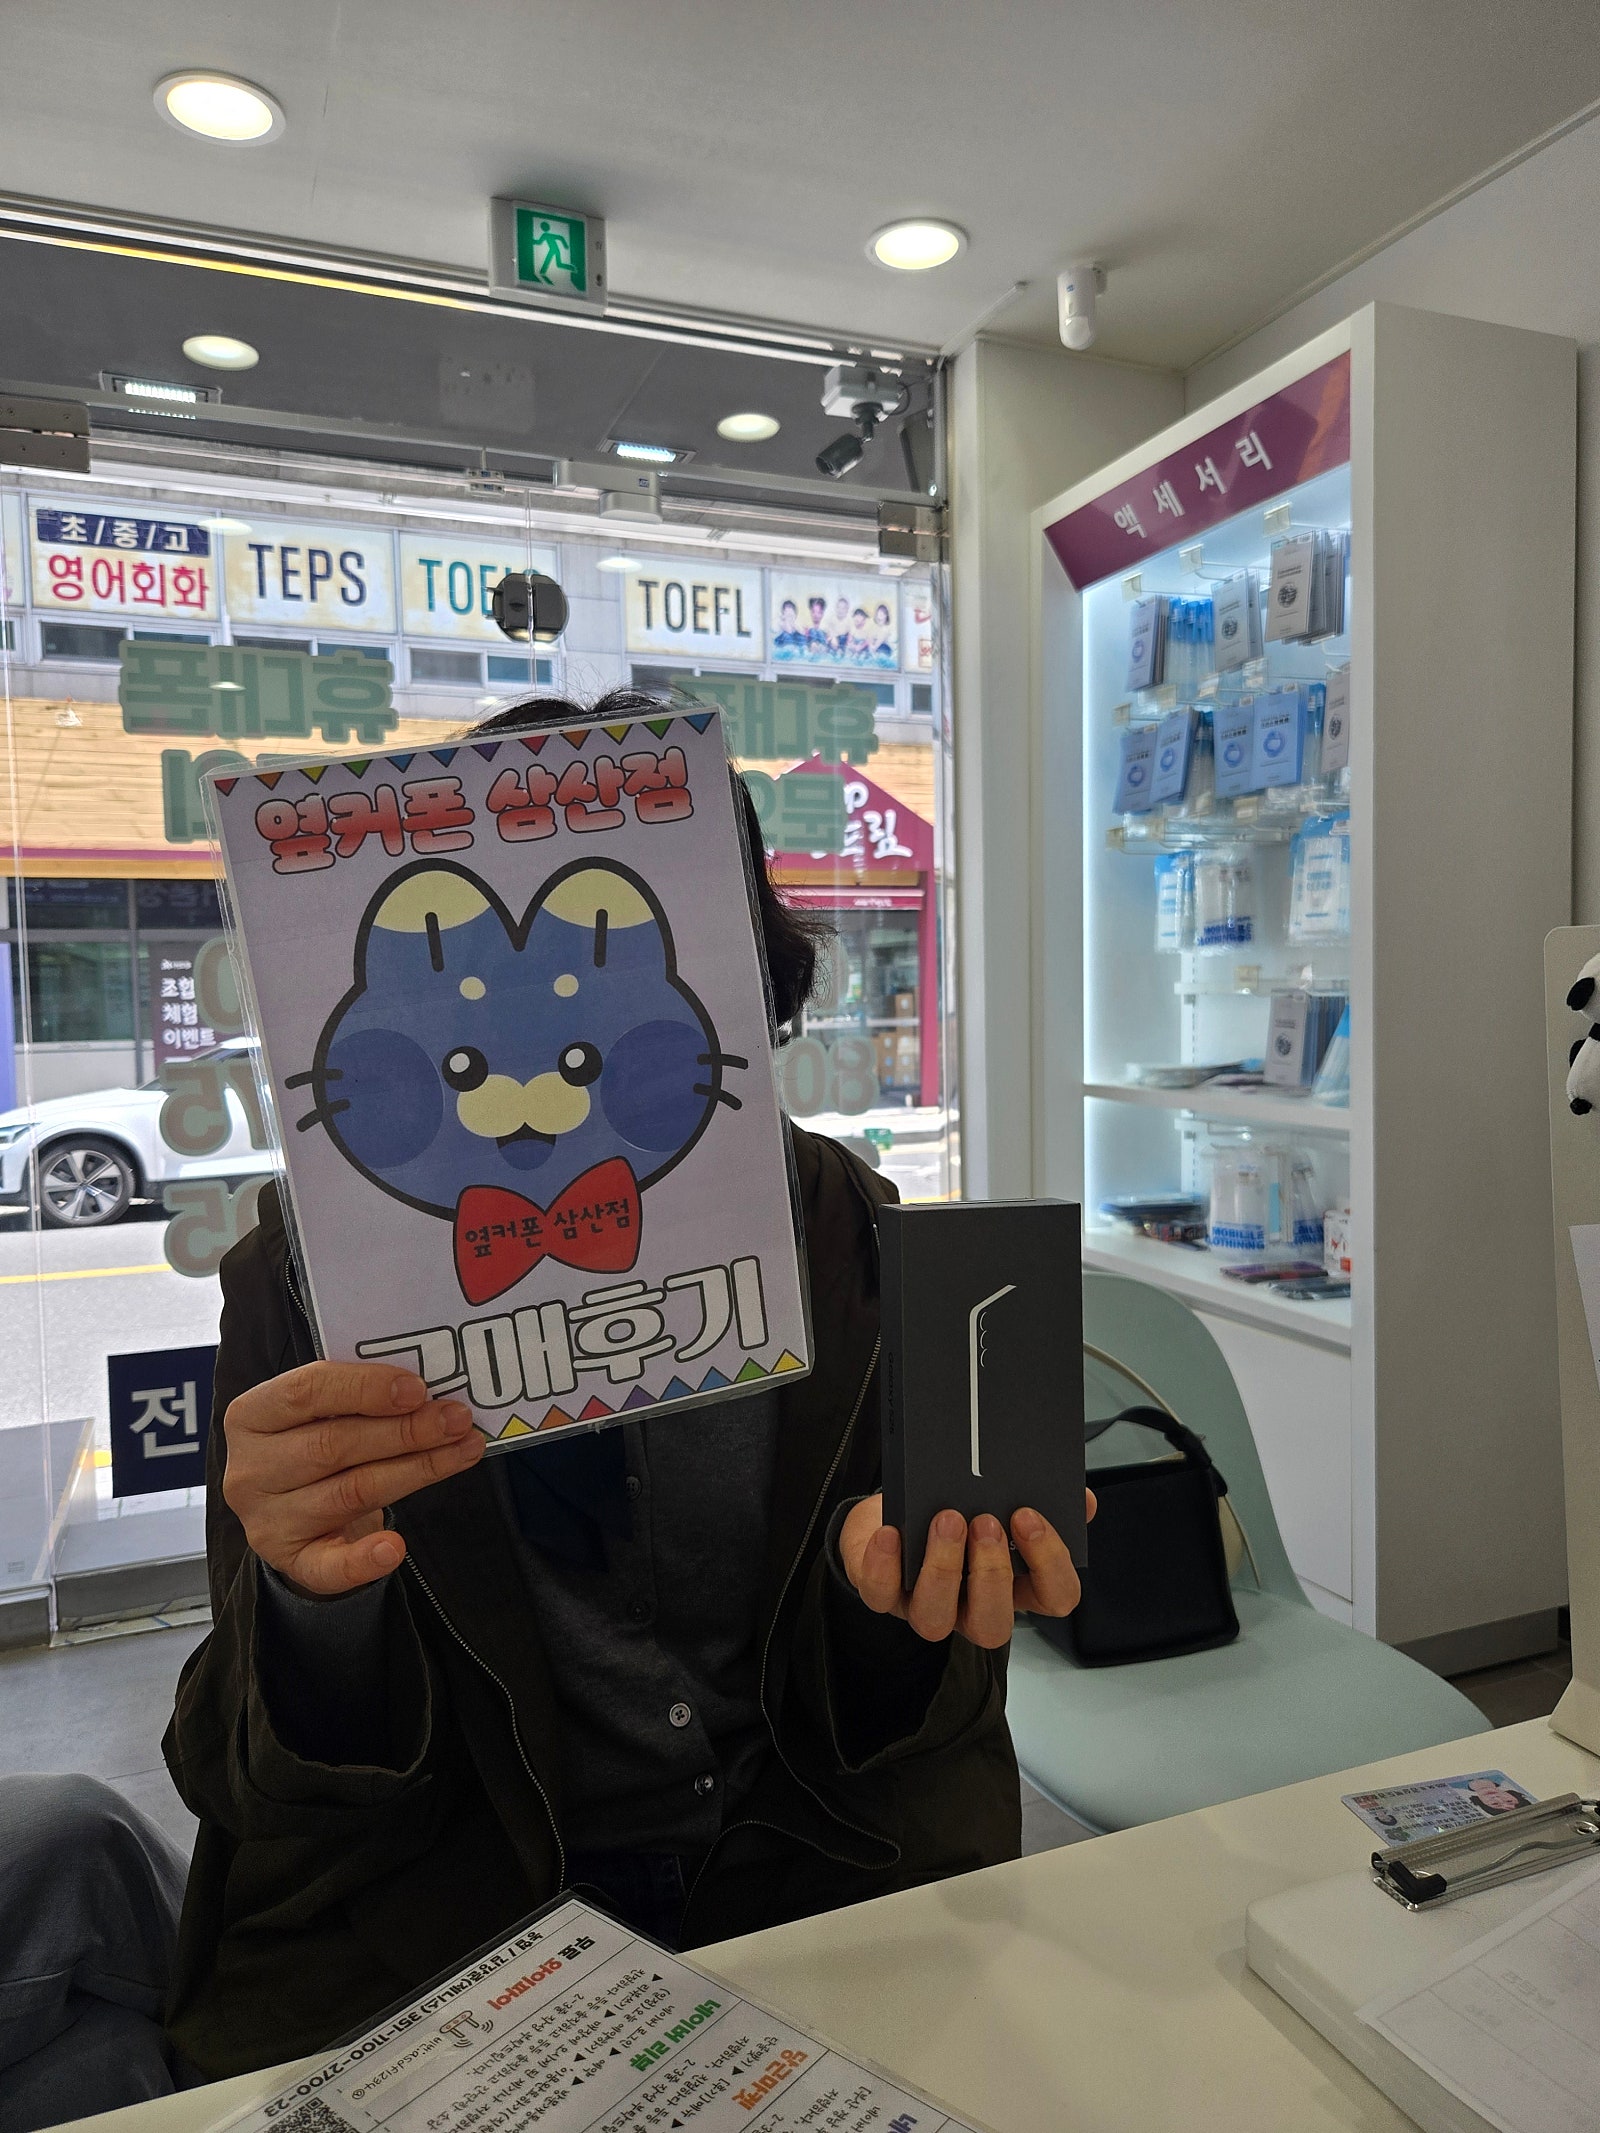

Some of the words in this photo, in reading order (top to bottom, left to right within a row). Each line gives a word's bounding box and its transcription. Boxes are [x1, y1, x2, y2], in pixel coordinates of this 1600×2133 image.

[1114, 431, 1273, 538] 액세서리
[61, 514, 190, 551] 초/중/고
[49, 554, 209, 610] 영어회화
[248, 543, 367, 607] TEPS
[638, 579, 751, 638] TOEFL
[256, 776, 475, 875] 옆커폰
[487, 746, 694, 843] 삼산점
[162, 1027, 217, 1051] 이벤트
[464, 1215, 544, 1257] 옆커폰
[552, 1199, 631, 1241] 삼산점
[129, 1380, 200, 1459] 전
[514, 1931, 544, 1951] 농협
[556, 1935, 596, 1961] 무료
[486, 1957, 563, 2011] 와이파이
[606, 1968, 646, 1996] 친절하다
[553, 1993, 585, 2015] 2-3줄
[586, 1996, 609, 2011] 등등
[613, 1983, 650, 2011] 리뷰쓰기
[531, 2015, 556, 2033] 작성
[548, 2010, 588, 2039] 솔직하고
[644, 2005, 676, 2028] 네이버
[663, 1999, 722, 2044] 네이버
[528, 2038, 551, 2055] 등등
[568, 2020, 602, 2046] 매장에
[584, 2023, 624, 2054] 예약하기
[619, 2025, 648, 2049] 로그인
[263, 2008, 423, 2118] 351-1100-2700-23
[537, 2043, 568, 2069] 오시게
[629, 2040, 671, 2072] 리뷰
[740, 2036, 779, 2068] 단골맺기
[487, 2053, 529, 2084] 솔직하고
[524, 2068, 540, 2079] 된
[582, 2059, 606, 2078] 예약
[663, 2058, 696, 2083] 2-3줄
[731, 2049, 809, 2111] 당근마켓
[451, 2085, 490, 2112] 간단한
[492, 2077, 526, 2103] 계기나
[642, 2083, 668, 2103] 작성
[666, 2073, 709, 2106] 친절하다
[426, 2110, 450, 2131] 소감
[645, 2107, 670, 2125] 등등
[850, 2106, 881, 2133] 네이버
[887, 2113, 918, 2133] 네
